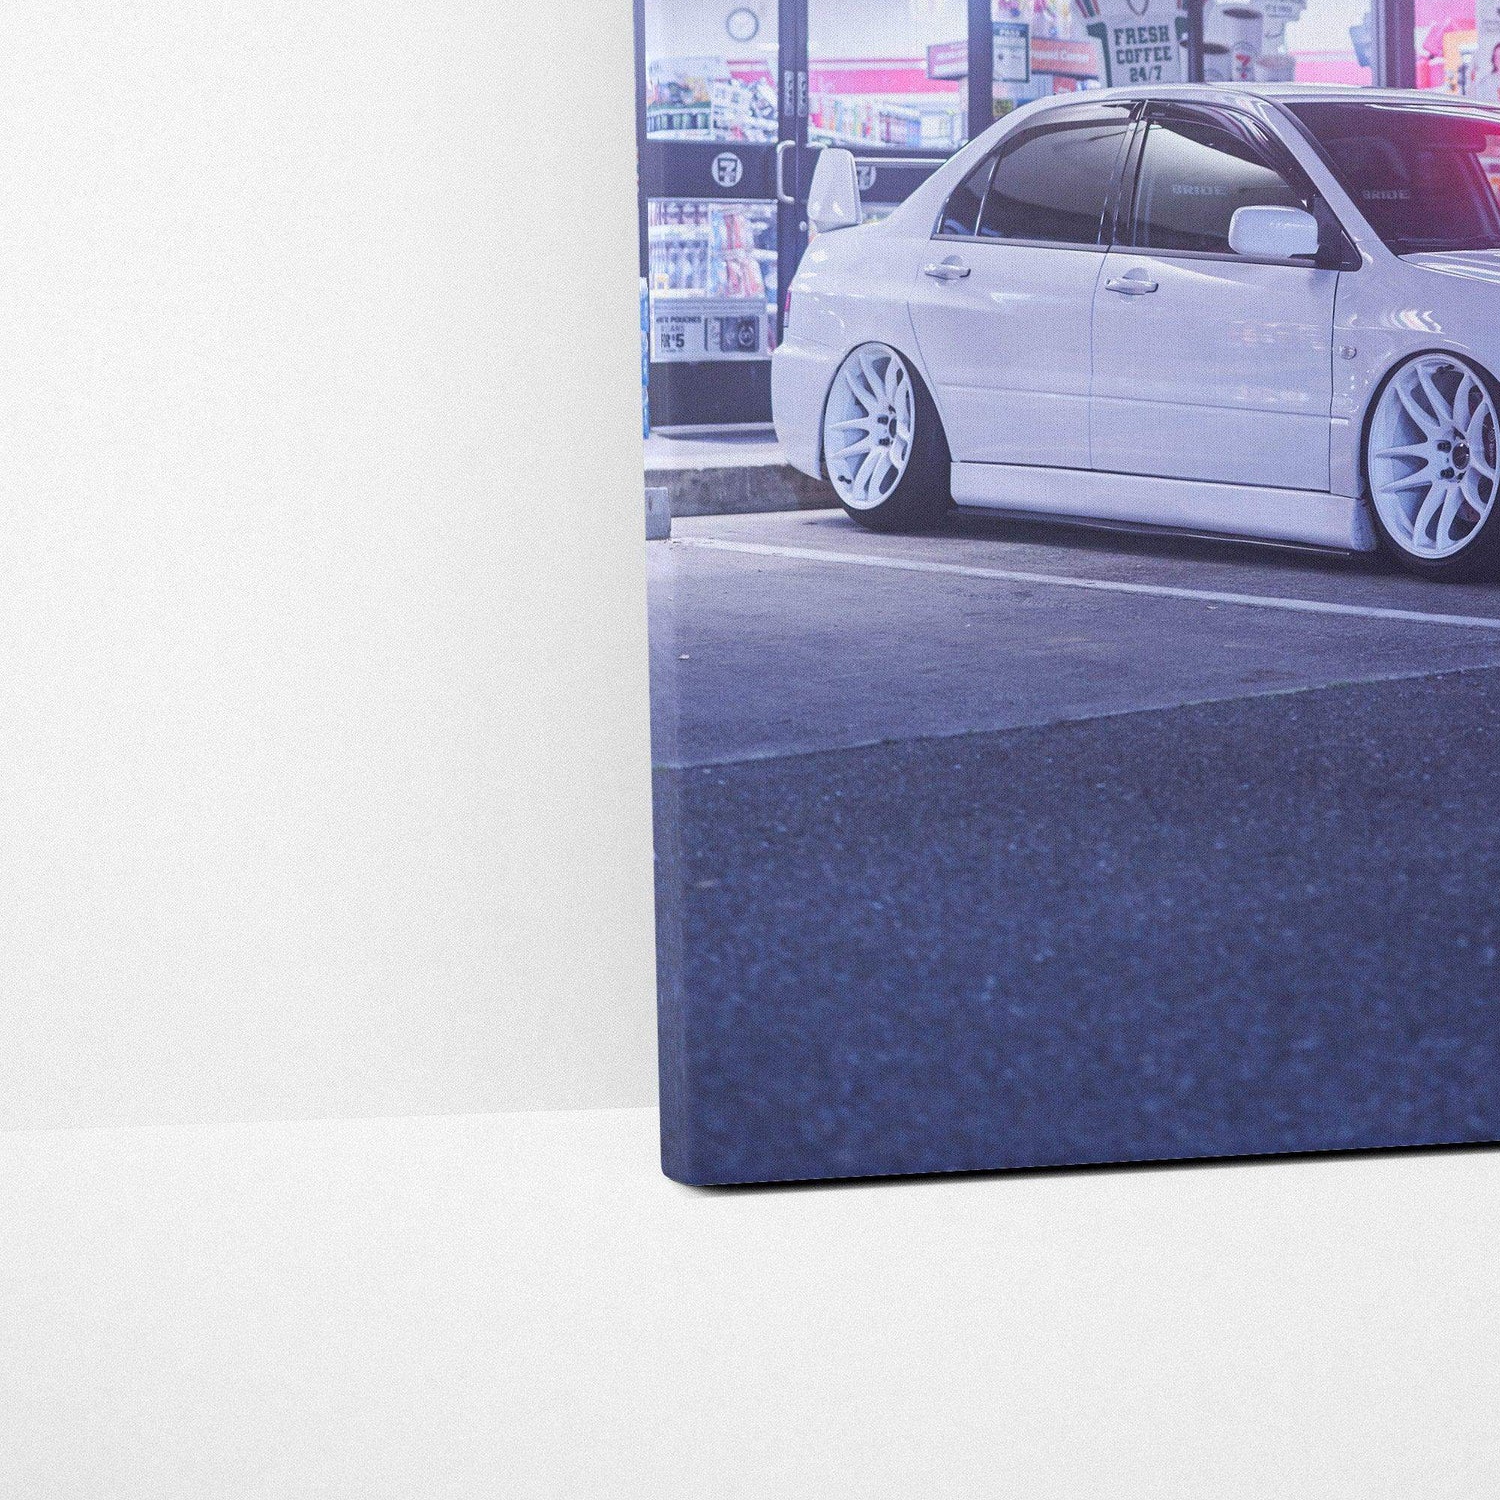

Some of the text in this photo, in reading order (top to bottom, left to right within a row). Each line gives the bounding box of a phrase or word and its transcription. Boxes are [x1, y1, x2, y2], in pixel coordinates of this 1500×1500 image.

[1113, 25, 1170, 47] FRESH
[1115, 46, 1172, 65] COFFEE
[1129, 65, 1162, 83] 24/7
